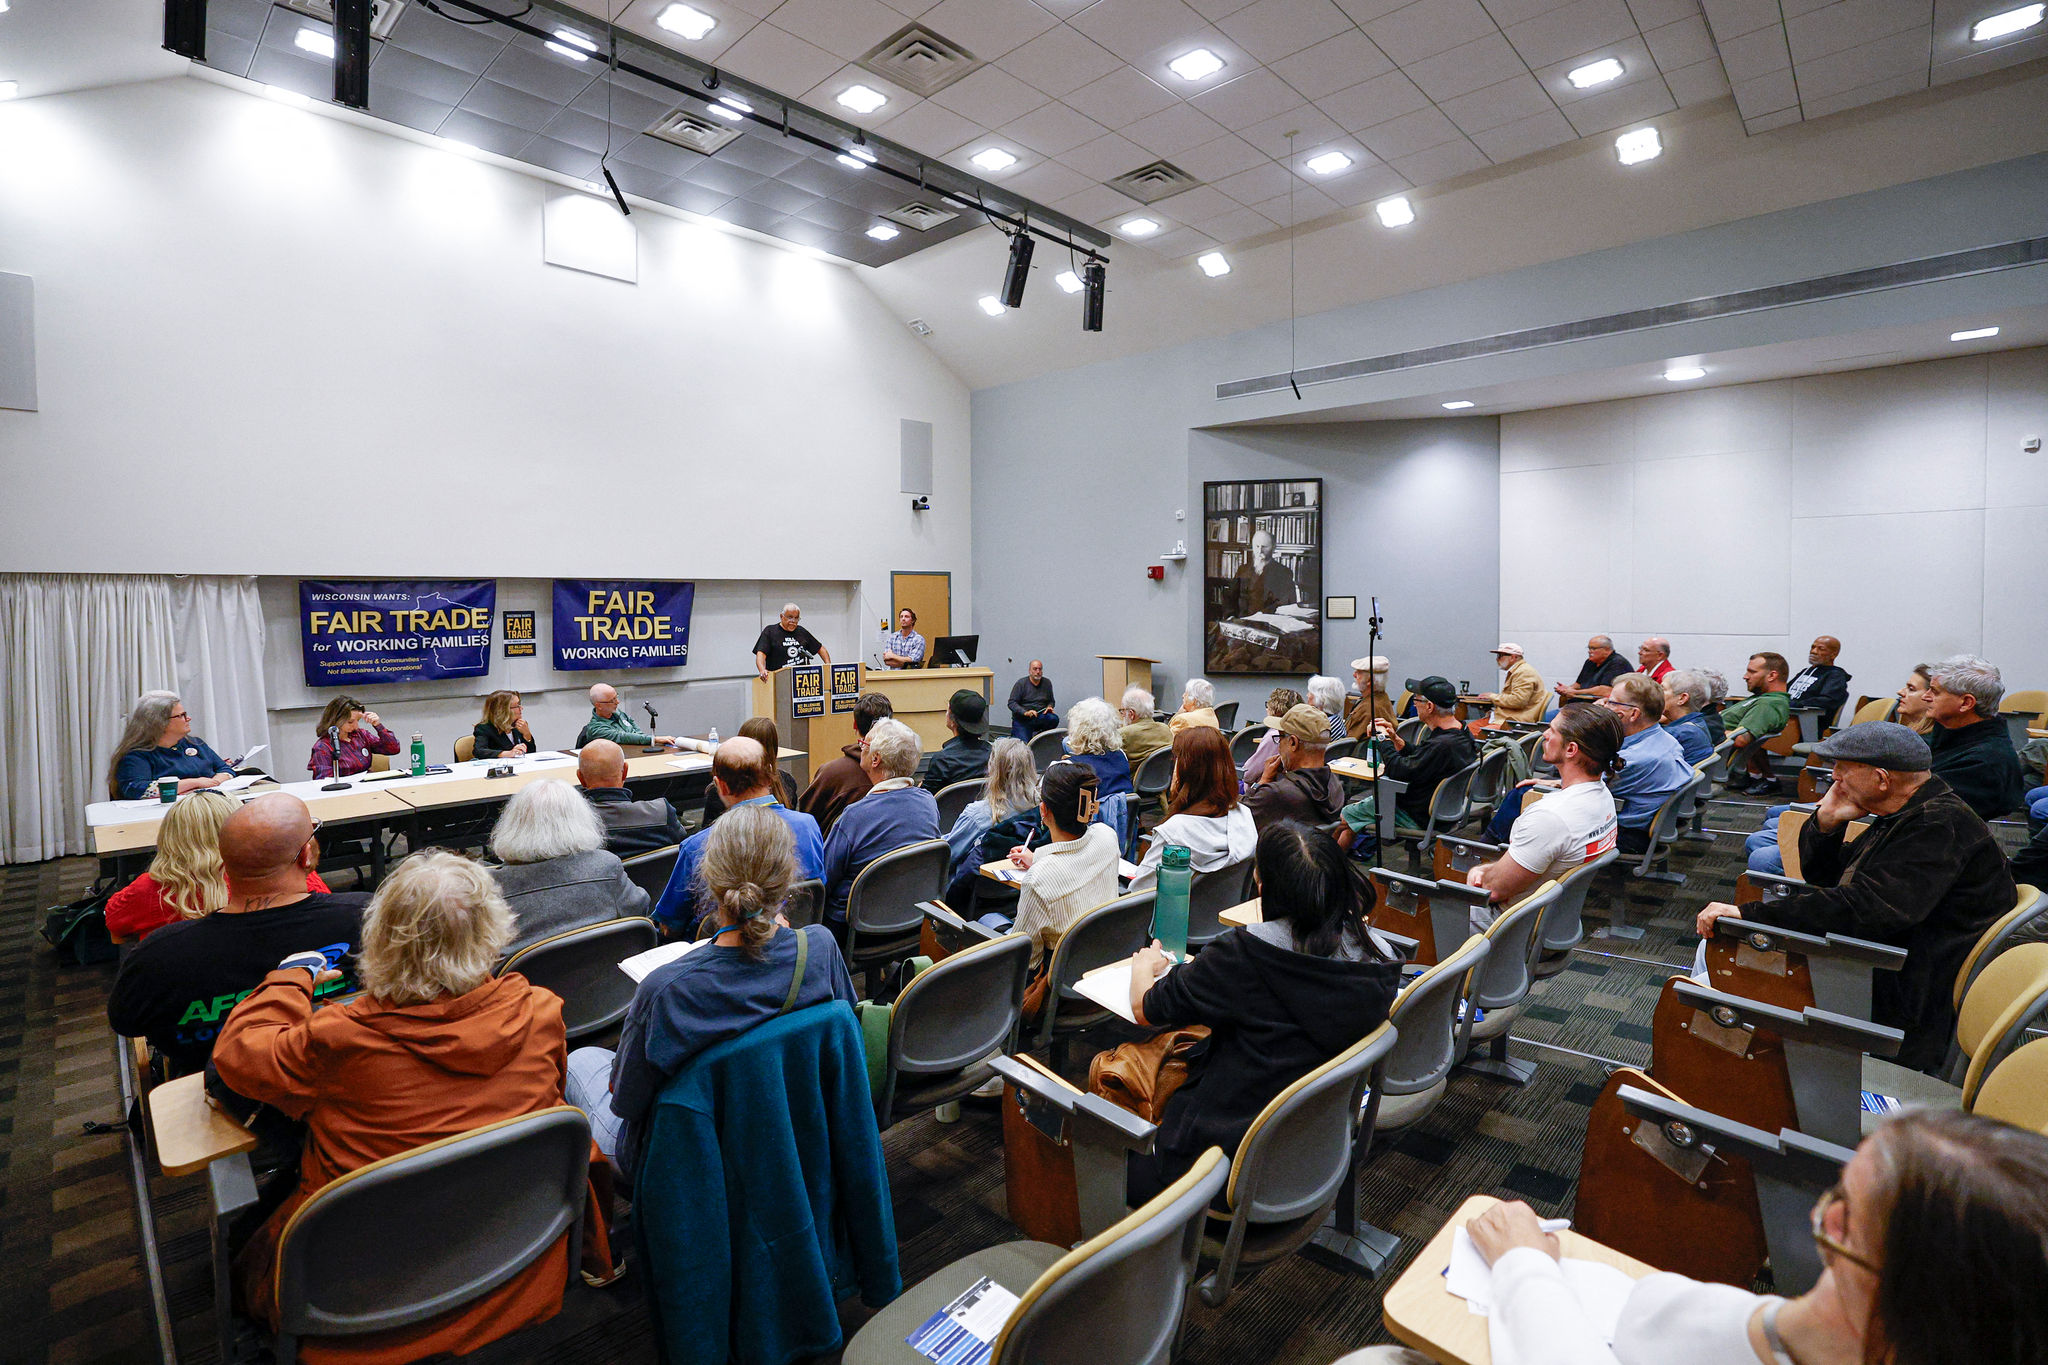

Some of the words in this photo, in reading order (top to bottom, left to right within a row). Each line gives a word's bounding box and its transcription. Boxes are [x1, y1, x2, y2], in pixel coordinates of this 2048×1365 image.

[311, 593, 370, 601] WISCONSIN
[373, 593, 411, 601] WANTS:
[588, 590, 655, 615] FAIR
[310, 610, 384, 635] FAIR
[389, 607, 489, 632] TRADE
[506, 618, 532, 630] FAIR
[507, 630, 532, 639] TRADE
[573, 616, 672, 641] TRADE
[312, 642, 332, 652] for
[336, 638, 418, 652] WORKING
[422, 634, 490, 649] FAMILIES
[561, 647, 629, 660] WORKING
[632, 644, 688, 658] FAMILIES
[340, 667, 375, 675] Billionaires
[382, 664, 422, 672] Corporations!
[796, 674, 820, 687] FAIR
[834, 672, 856, 685] FAIR
[796, 687, 820, 697] TRADE
[835, 684, 856, 693] TRADE
